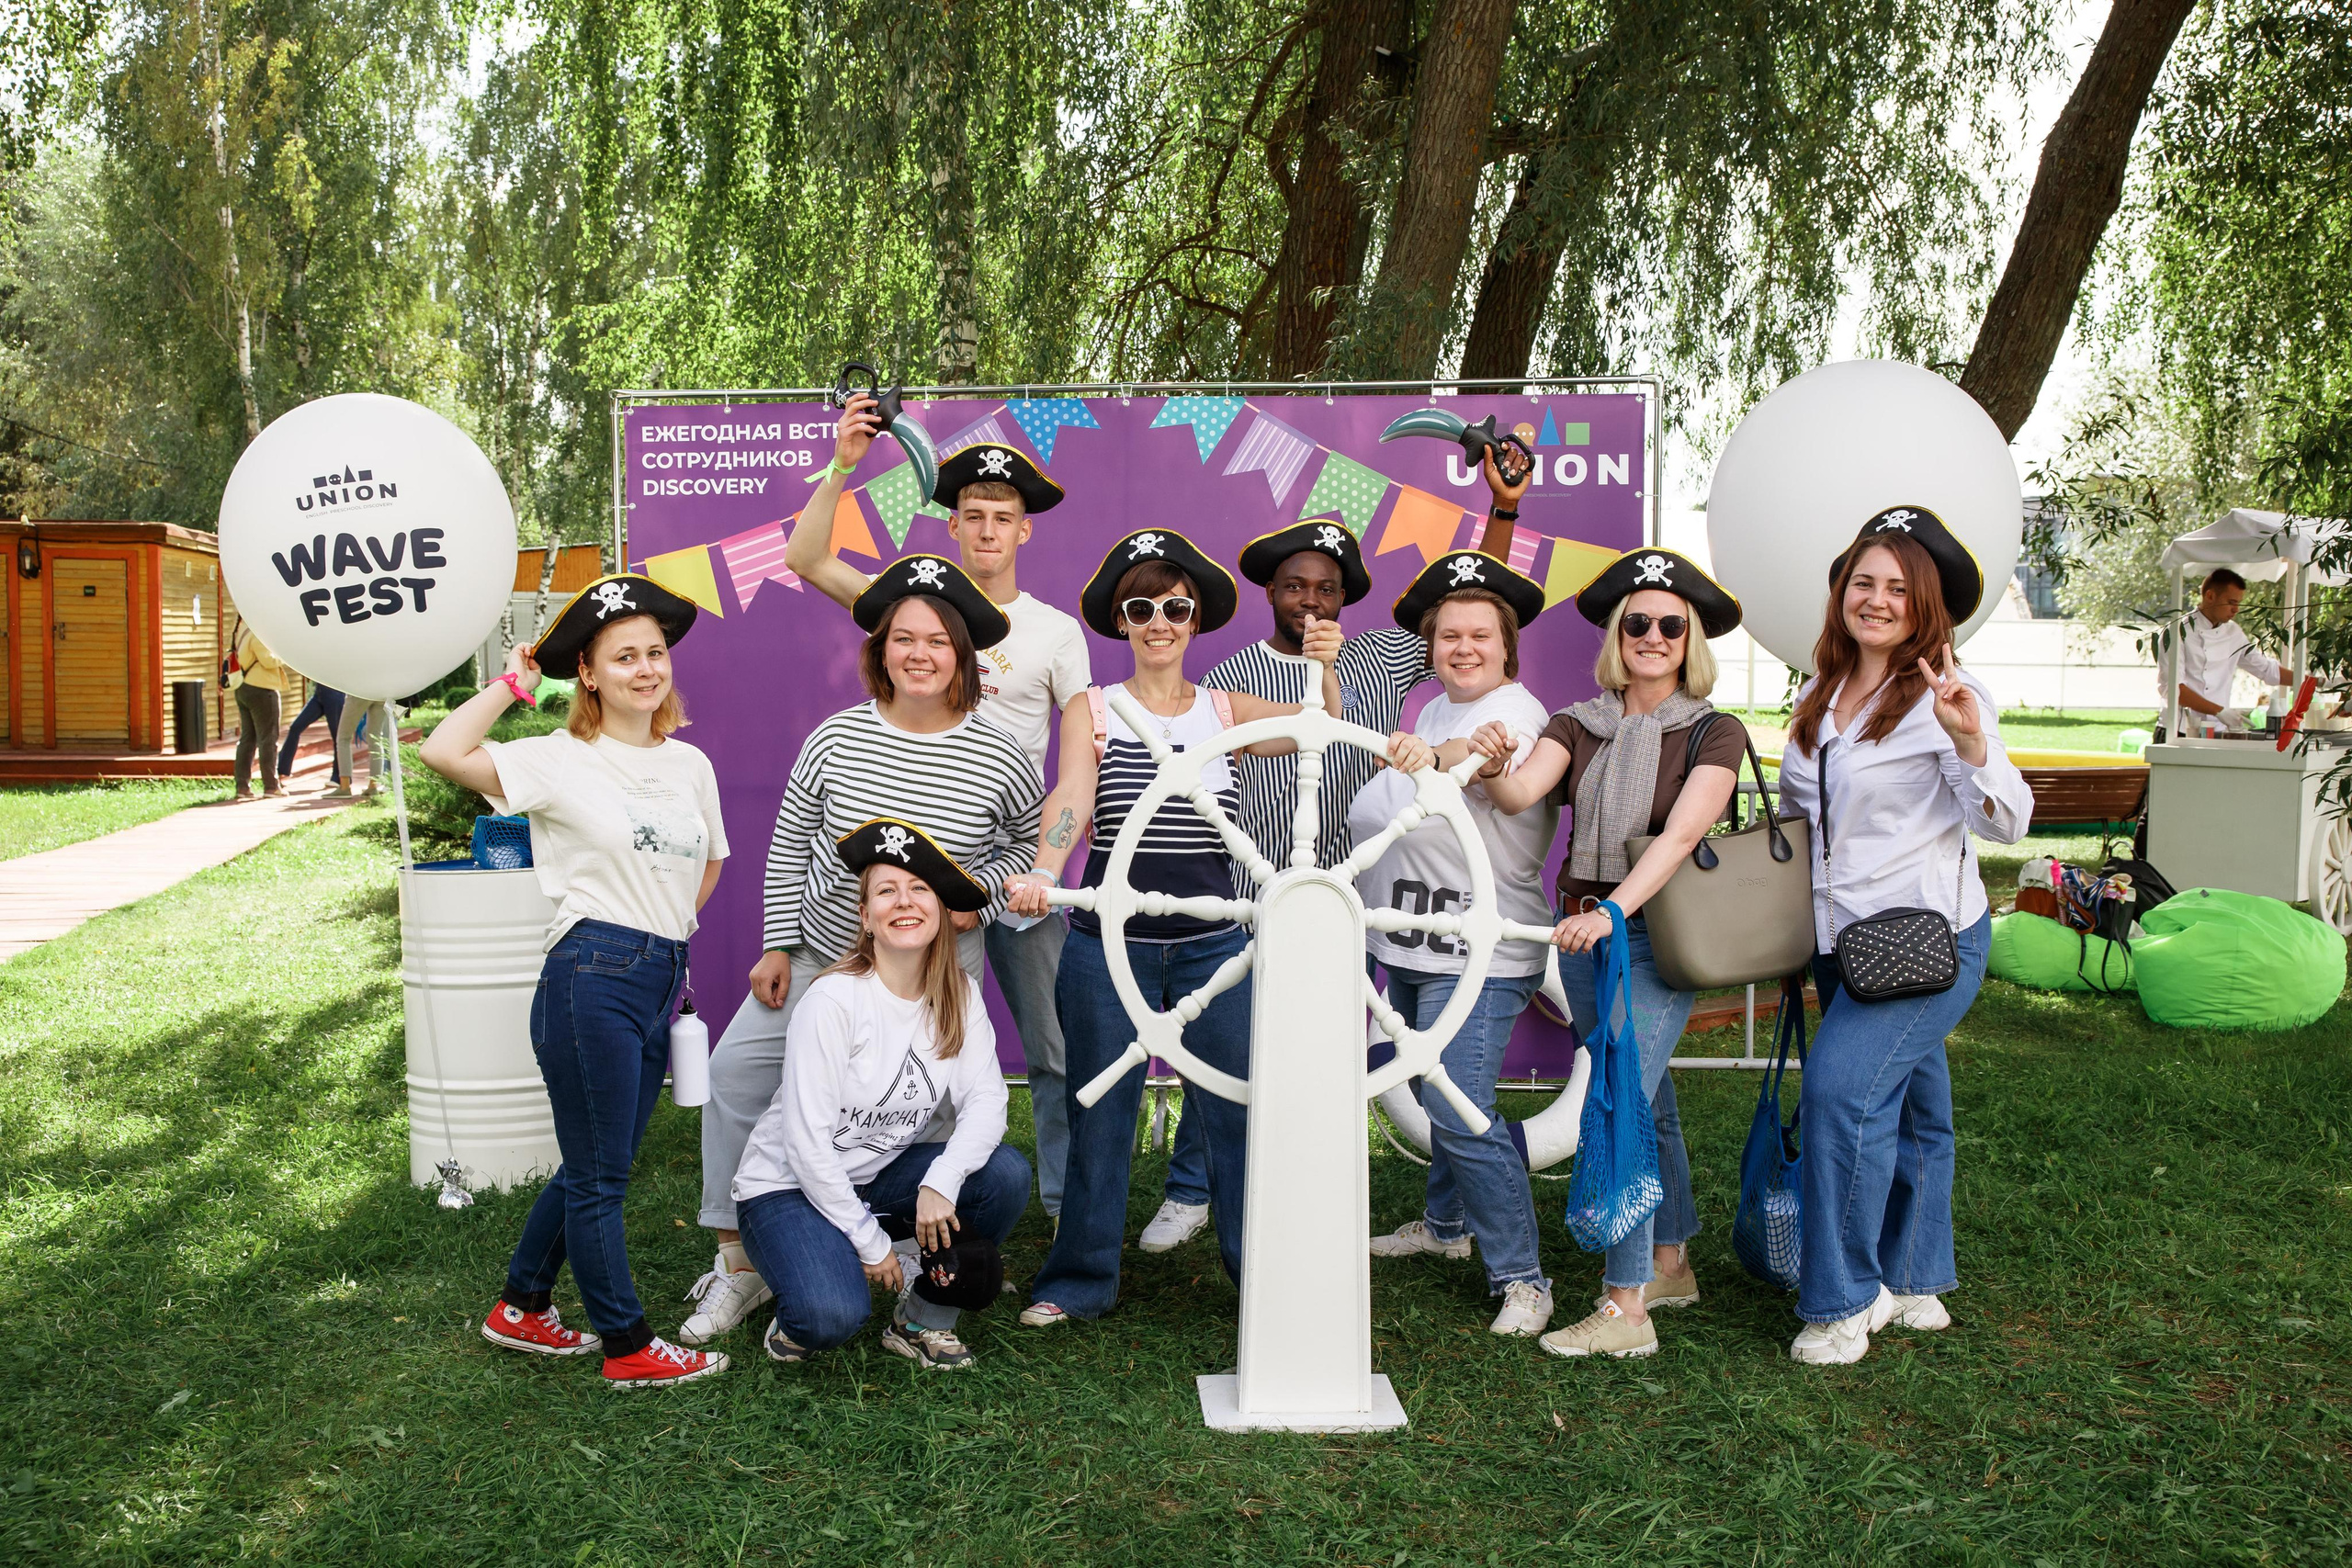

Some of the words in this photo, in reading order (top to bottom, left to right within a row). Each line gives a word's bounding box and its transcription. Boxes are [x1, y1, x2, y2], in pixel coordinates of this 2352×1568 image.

[641, 423, 782, 444] ЕЖЕГОДНАЯ
[641, 449, 813, 470] СОТРУДНИКОВ
[1446, 453, 1630, 487] UION
[295, 482, 398, 512] UNION
[642, 478, 769, 496] DISCOVERY
[306, 510, 328, 520] ENGLISH
[330, 504, 362, 514] PRESCHOOL
[363, 501, 394, 510] DISCOVERY
[271, 526, 447, 588] WAVE
[300, 576, 436, 627] FEST
[850, 1106, 932, 1128] KAMCHAT
